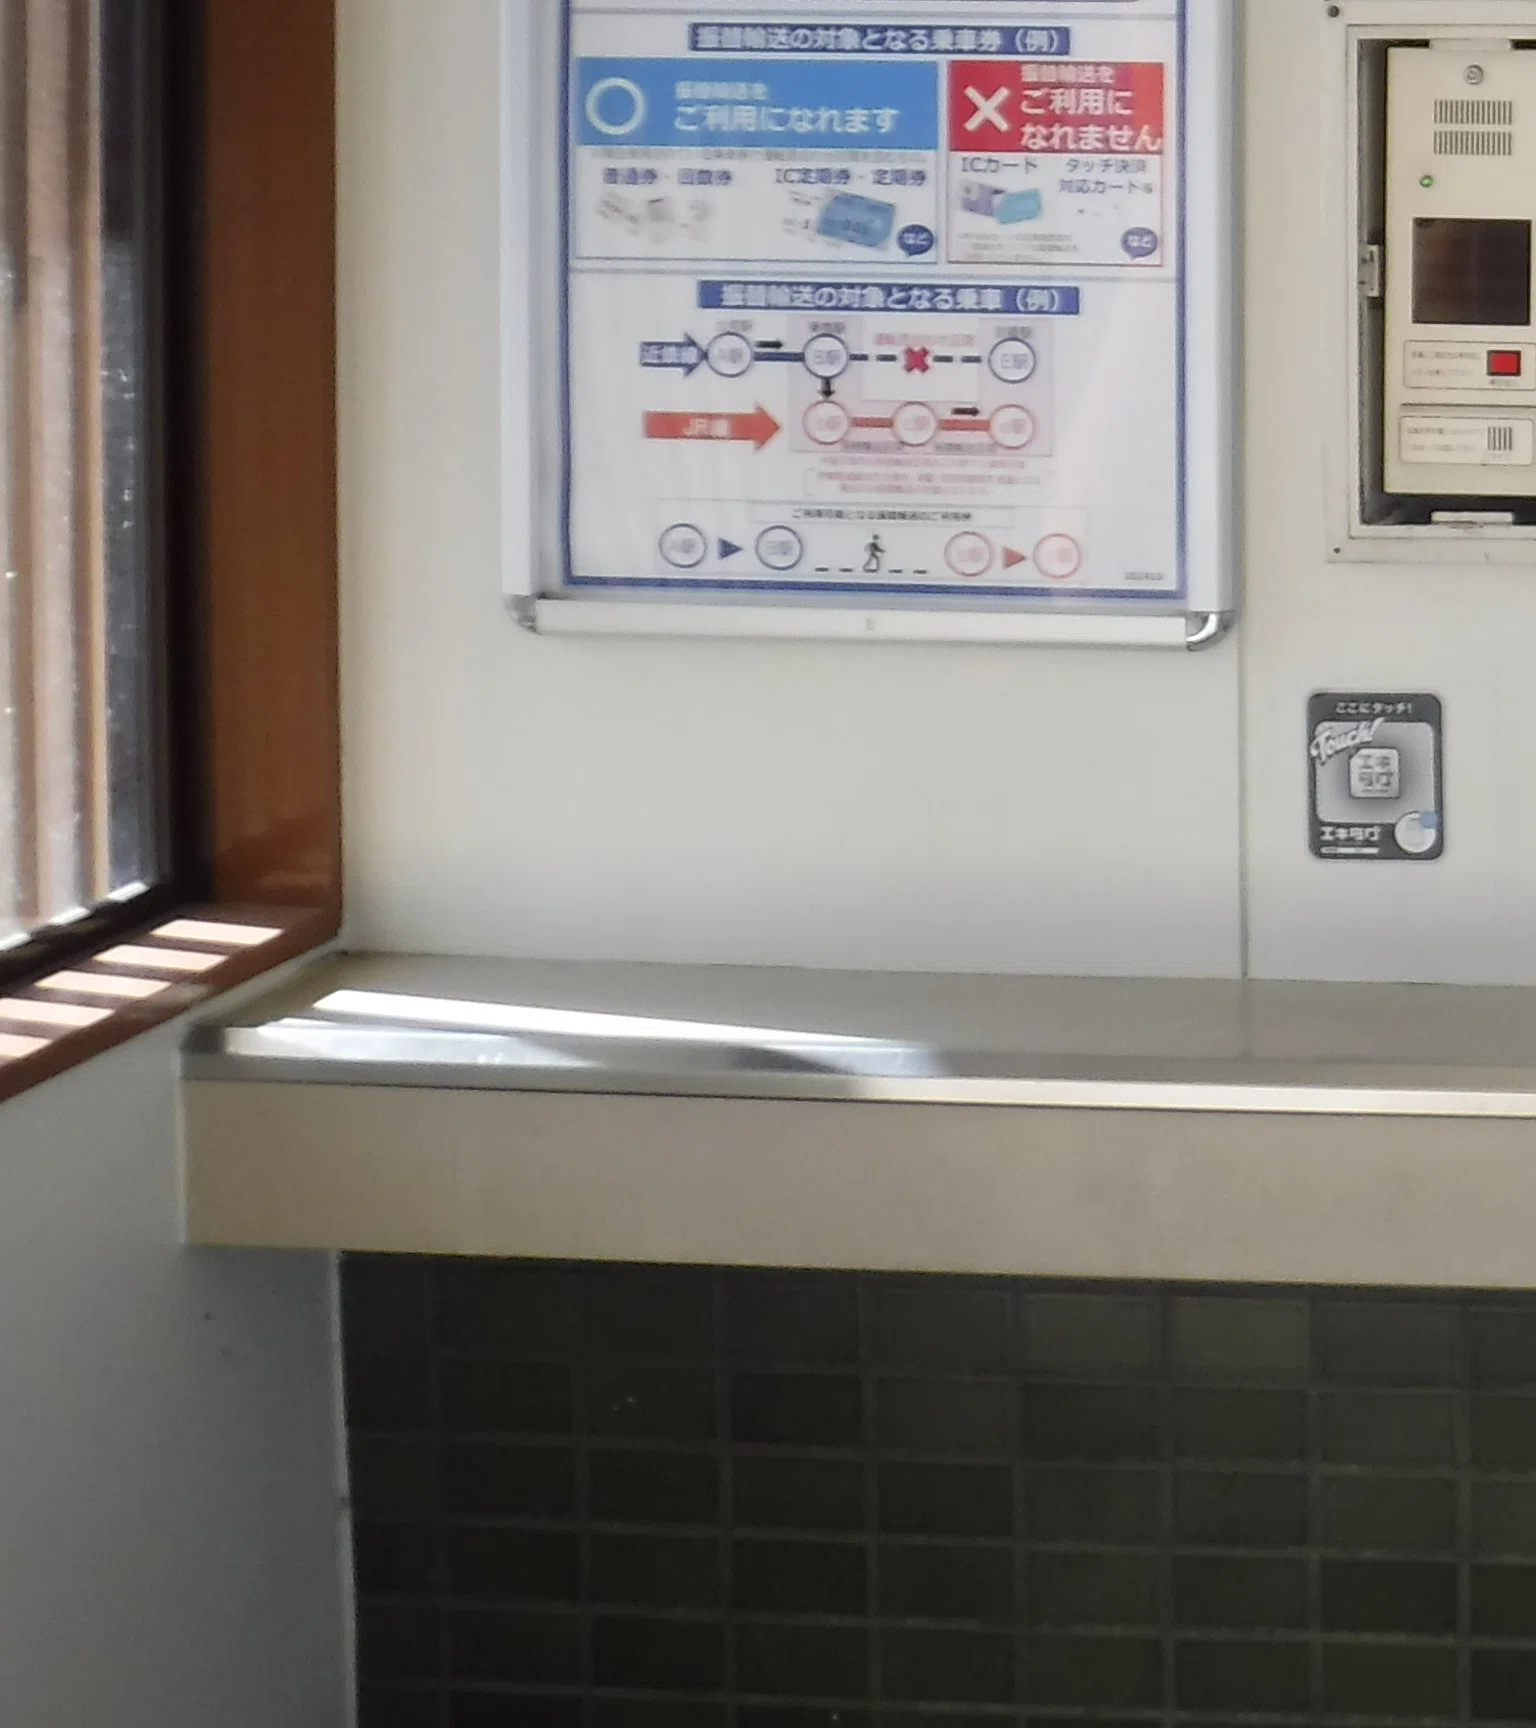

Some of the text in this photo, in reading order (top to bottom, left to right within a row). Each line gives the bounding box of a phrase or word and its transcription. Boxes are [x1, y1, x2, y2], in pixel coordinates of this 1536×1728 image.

[1021, 88, 1132, 115] ご利用に
[675, 105, 899, 133] ご利用になれます
[1021, 124, 1162, 151] なれません
